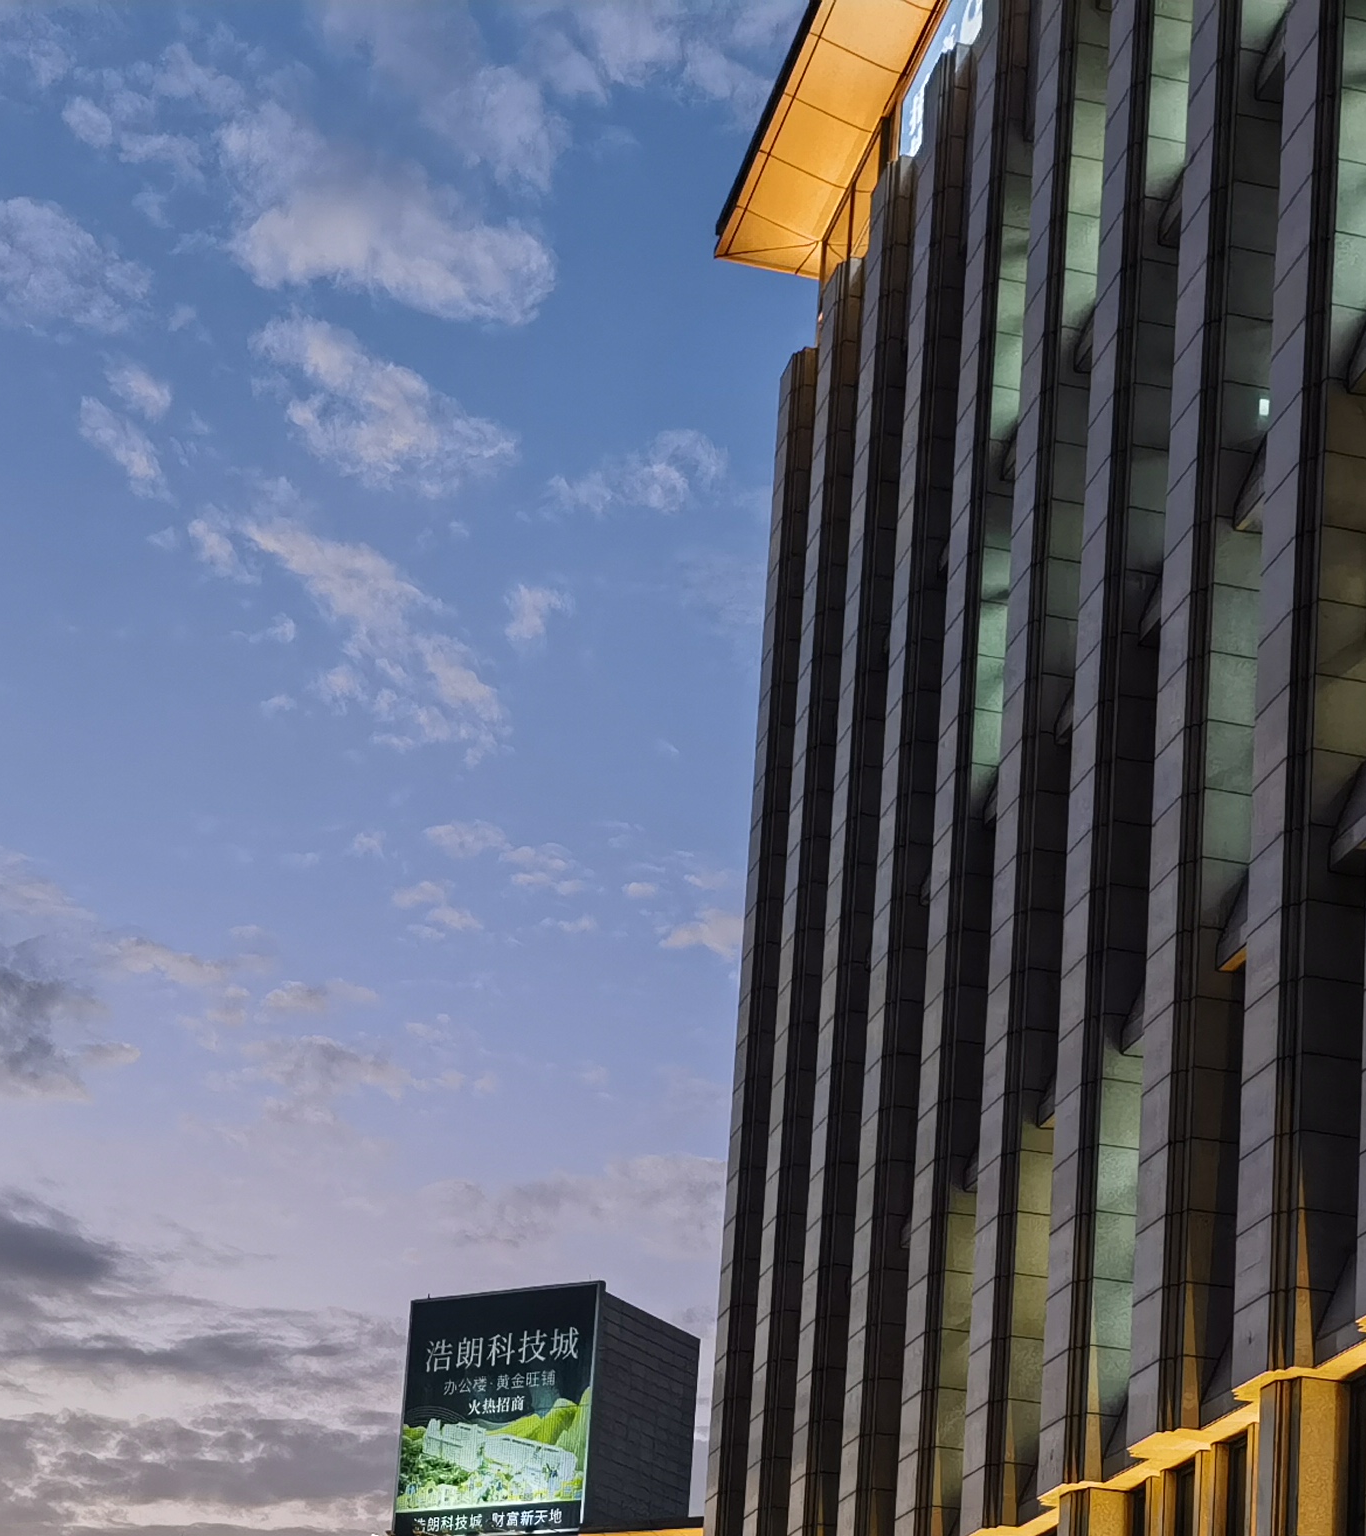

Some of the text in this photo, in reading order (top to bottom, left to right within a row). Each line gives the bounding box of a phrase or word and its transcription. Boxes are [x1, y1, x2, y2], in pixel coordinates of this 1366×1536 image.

[426, 1326, 579, 1373] 浩朗科技城
[468, 1395, 525, 1416] 火热招商
[492, 1508, 562, 1528] 财富新天地
